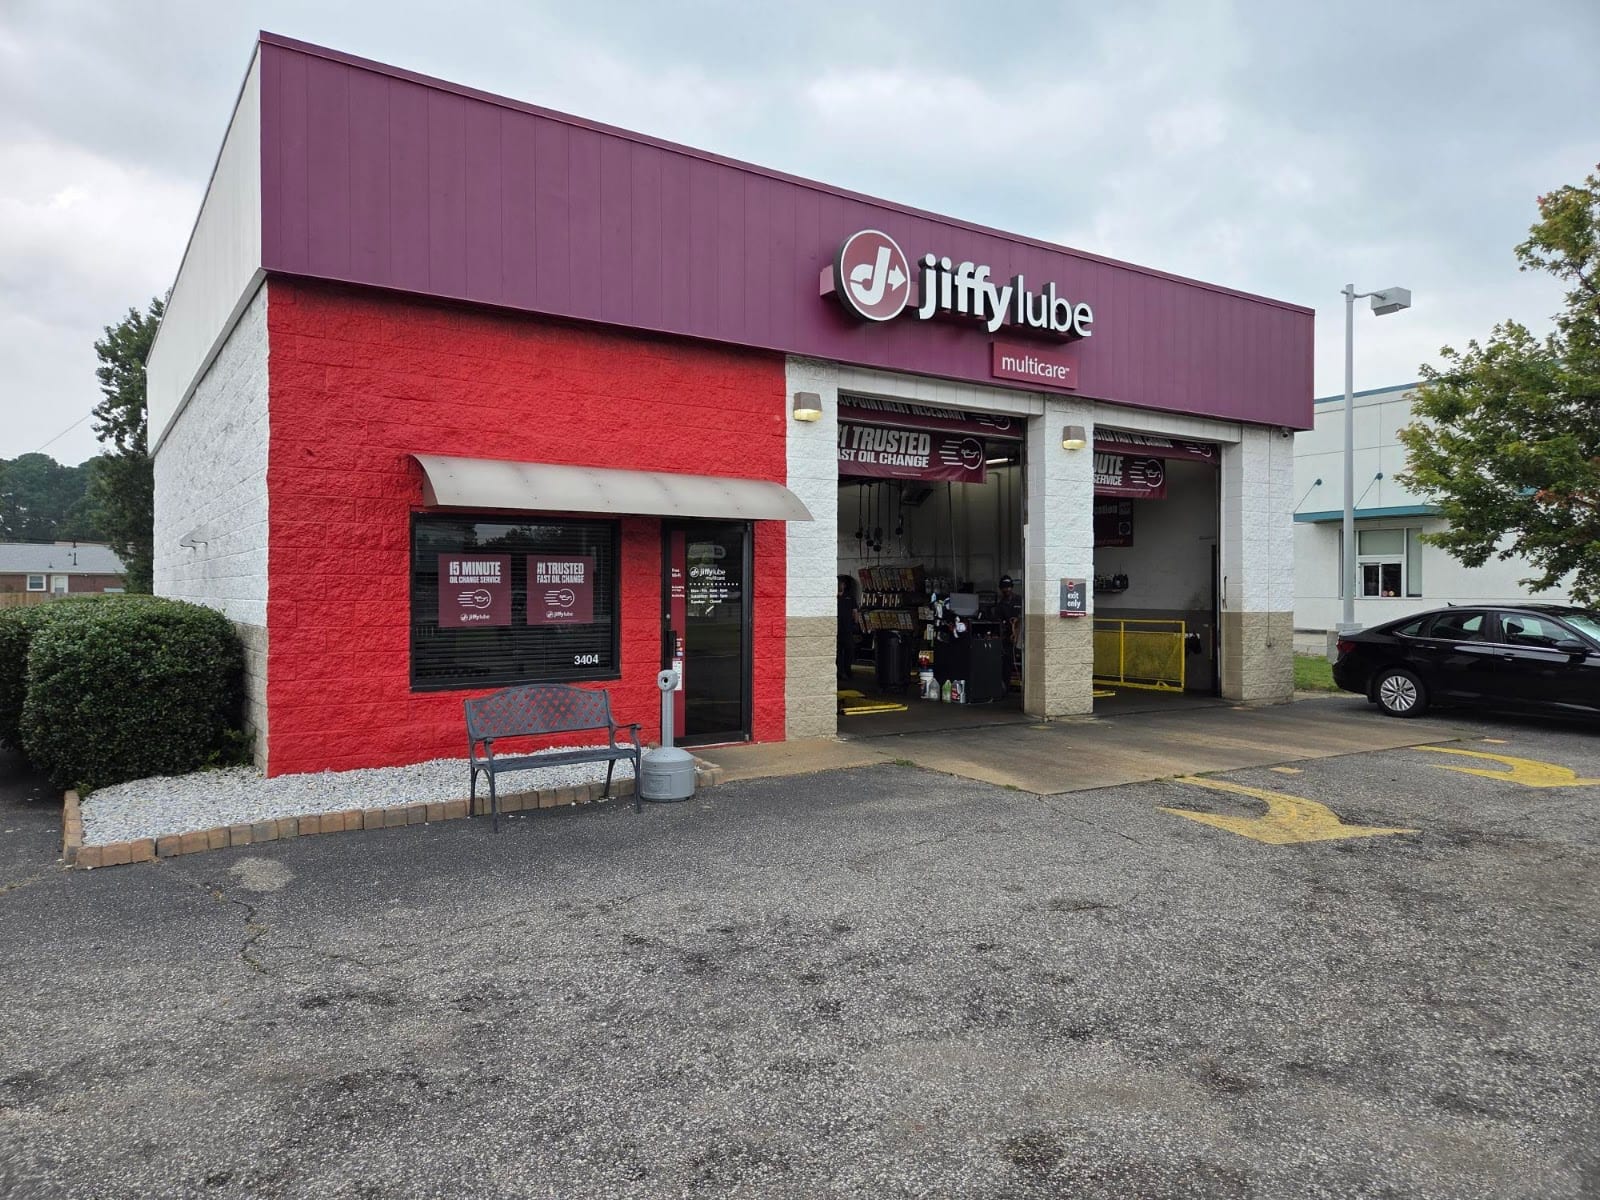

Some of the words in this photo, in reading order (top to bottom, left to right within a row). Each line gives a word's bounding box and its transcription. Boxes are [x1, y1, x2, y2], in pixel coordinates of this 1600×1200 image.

[852, 426, 931, 456] TRUSTED
[857, 450, 877, 464] OIL
[879, 452, 930, 469] CHANGE
[449, 561, 460, 576] 15
[462, 561, 501, 576] MINUTE
[537, 562, 546, 575] #1
[547, 562, 585, 575] TRUSTED
[449, 576, 458, 584] OIL
[458, 576, 479, 584] CHANGE
[479, 576, 501, 584] SERVICE
[537, 575, 551, 584] FAST
[551, 575, 561, 584] OIL
[561, 575, 585, 584] CHANGE
[574, 654, 599, 665] 3404
